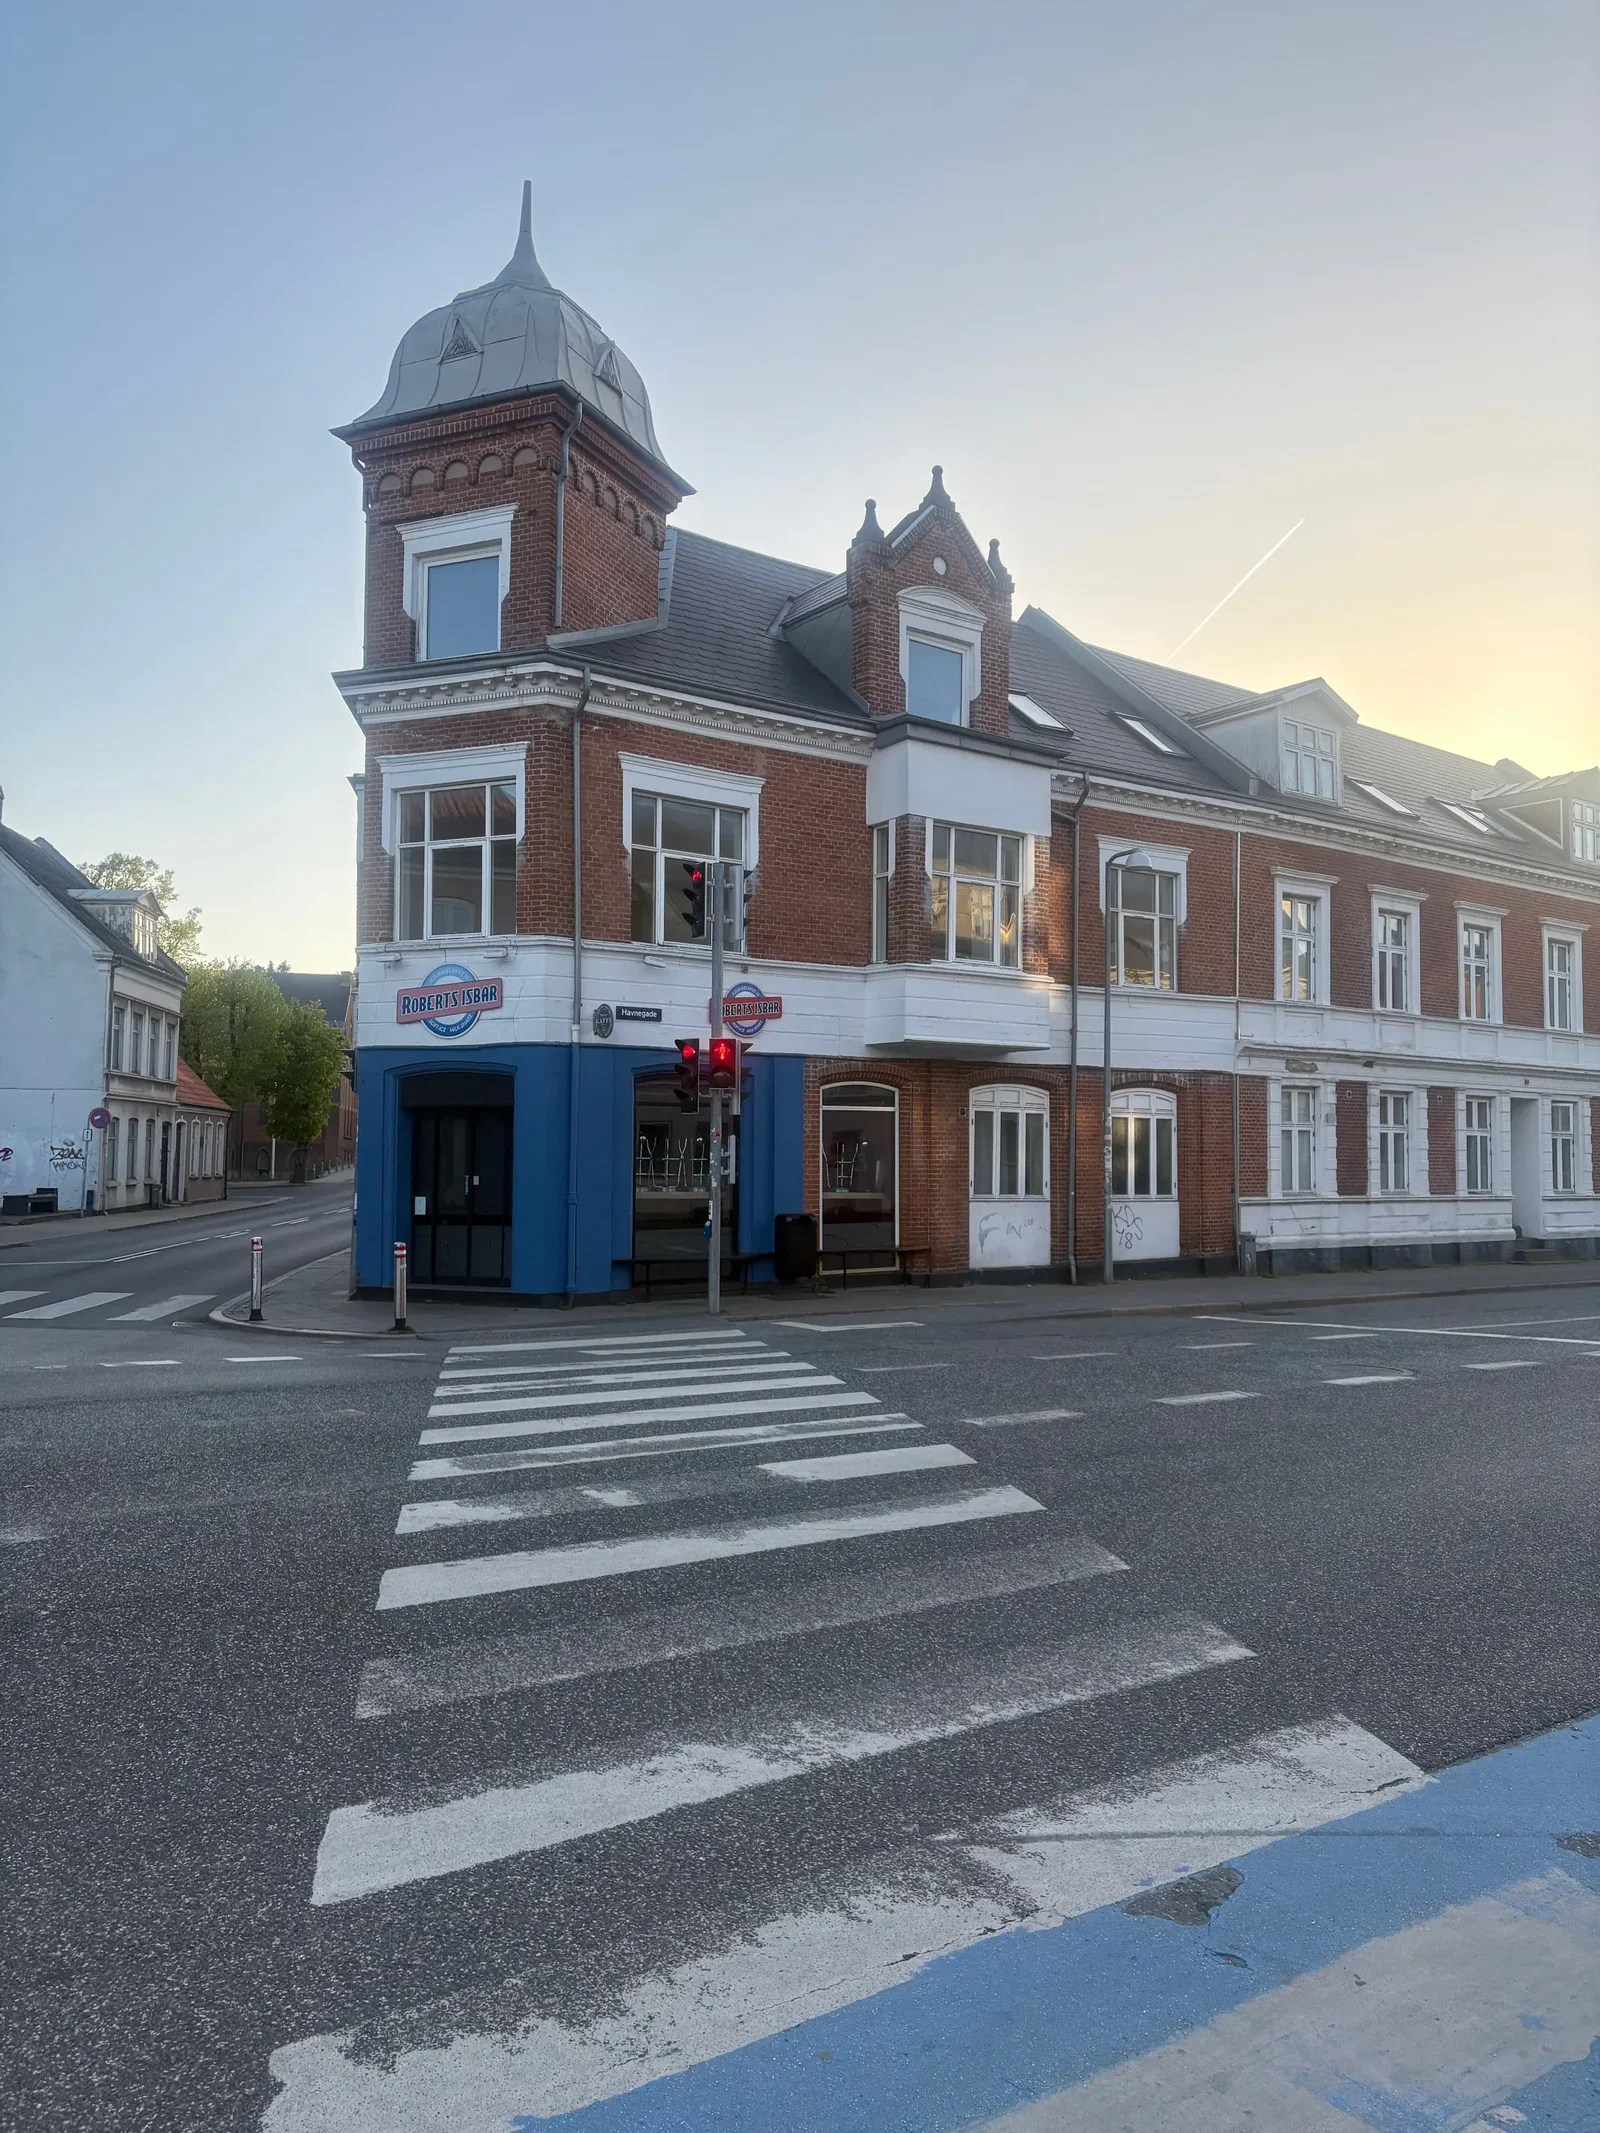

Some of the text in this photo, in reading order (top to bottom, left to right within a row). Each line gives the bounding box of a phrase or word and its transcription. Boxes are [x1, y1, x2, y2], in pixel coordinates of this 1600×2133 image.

[401, 984, 498, 1015] ROBERTS ISBAR
[621, 1008, 658, 1018] Havnegade
[722, 1001, 780, 1016] BERTS ISBAR
